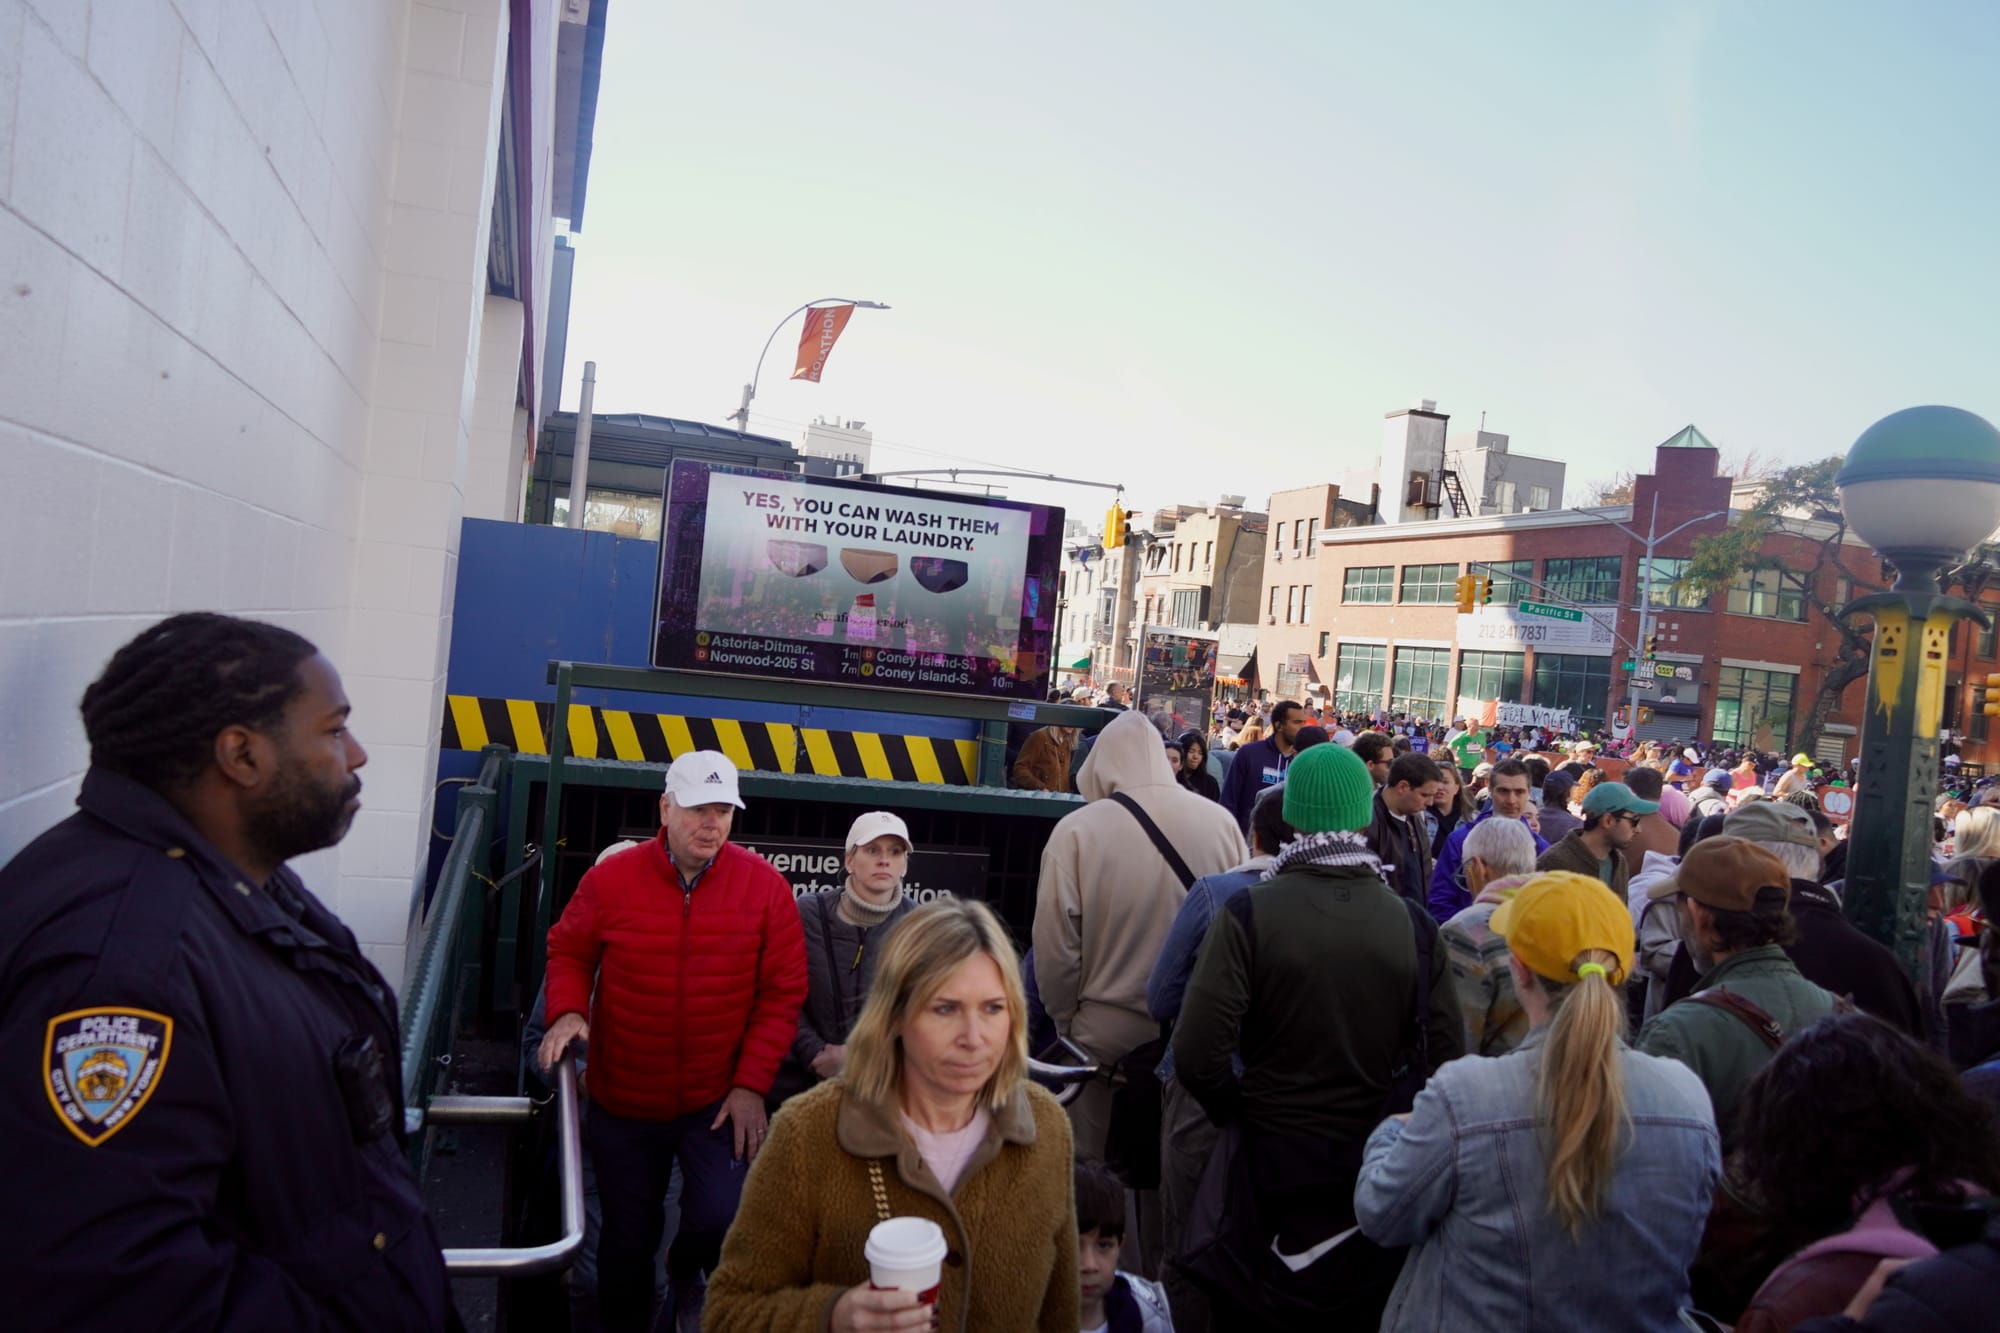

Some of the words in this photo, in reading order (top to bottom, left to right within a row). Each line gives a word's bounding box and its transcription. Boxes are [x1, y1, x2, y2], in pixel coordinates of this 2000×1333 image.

[743, 490, 785, 513] YES,
[793, 496, 833, 515] YOU
[838, 502, 880, 521] CAN
[885, 508, 942, 529] WASH
[947, 516, 1000, 536] THEM
[766, 513, 818, 533] WITH
[823, 519, 878, 540] YOUR
[882, 527, 975, 552] LAUNDRY.
[1528, 604, 1562, 617] Pacific
[1563, 610, 1575, 620] St
[709, 650, 798, 669] Norwood-205
[800, 658, 815, 672] St
[841, 661, 858, 674] 7m
[843, 647, 859, 659] 1m
[876, 650, 918, 667] Coney
[875, 665, 916, 682] Coney
[991, 676, 1014, 688] 10m
[80, 1016, 140, 1033] POLICE
[56, 1029, 159, 1054] DEPARTMENT
[51, 1068, 72, 1102] CITY
